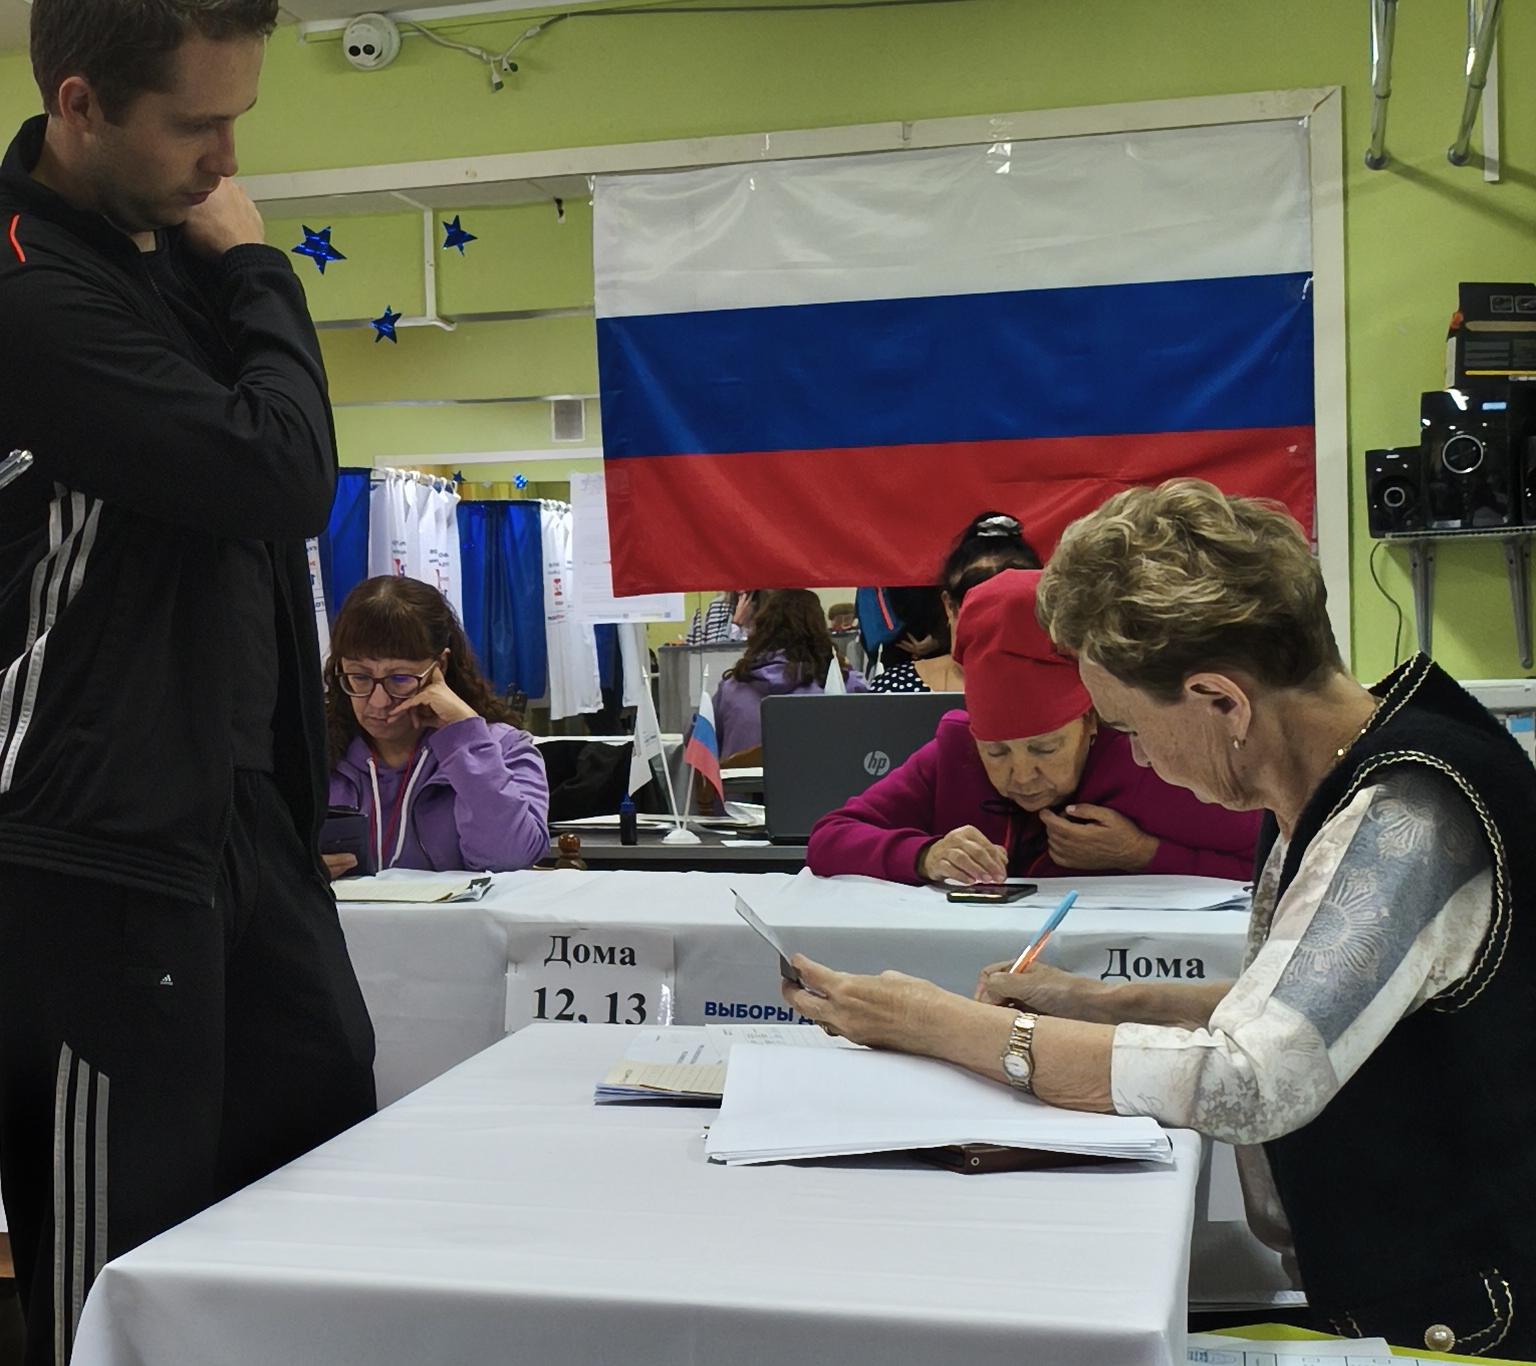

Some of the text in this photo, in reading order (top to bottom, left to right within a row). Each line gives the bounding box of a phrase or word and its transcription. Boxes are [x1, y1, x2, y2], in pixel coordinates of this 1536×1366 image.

[864, 750, 891, 776] hp
[543, 934, 637, 968] Дома
[1100, 947, 1206, 982] Дома
[604, 991, 647, 1025] 13
[704, 1001, 794, 1022] ВЫБОРЫ
